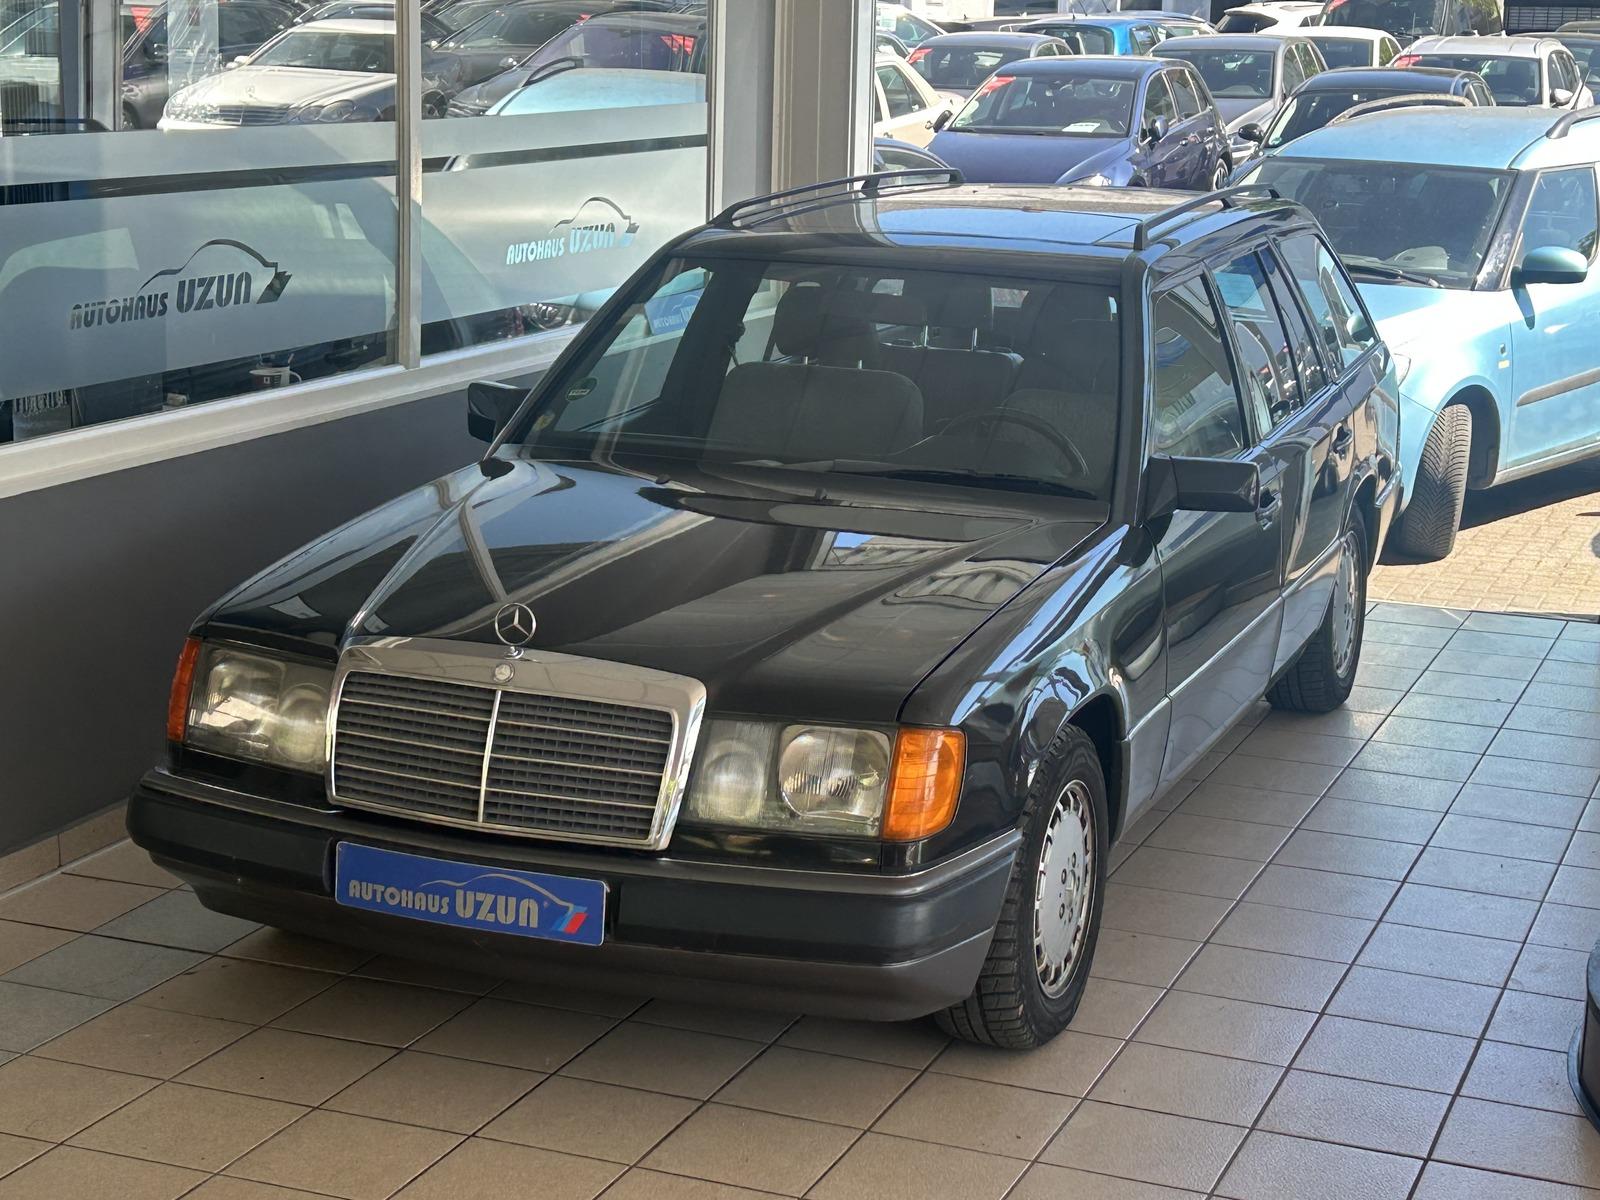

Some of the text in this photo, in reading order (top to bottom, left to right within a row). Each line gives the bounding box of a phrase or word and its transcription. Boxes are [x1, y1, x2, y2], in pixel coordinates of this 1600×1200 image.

[506, 223, 616, 265] AUTOHAUS UZUN
[70, 271, 252, 330] AUTOHAUS UZUN
[349, 879, 539, 928] AUTOHAUS UZUN
